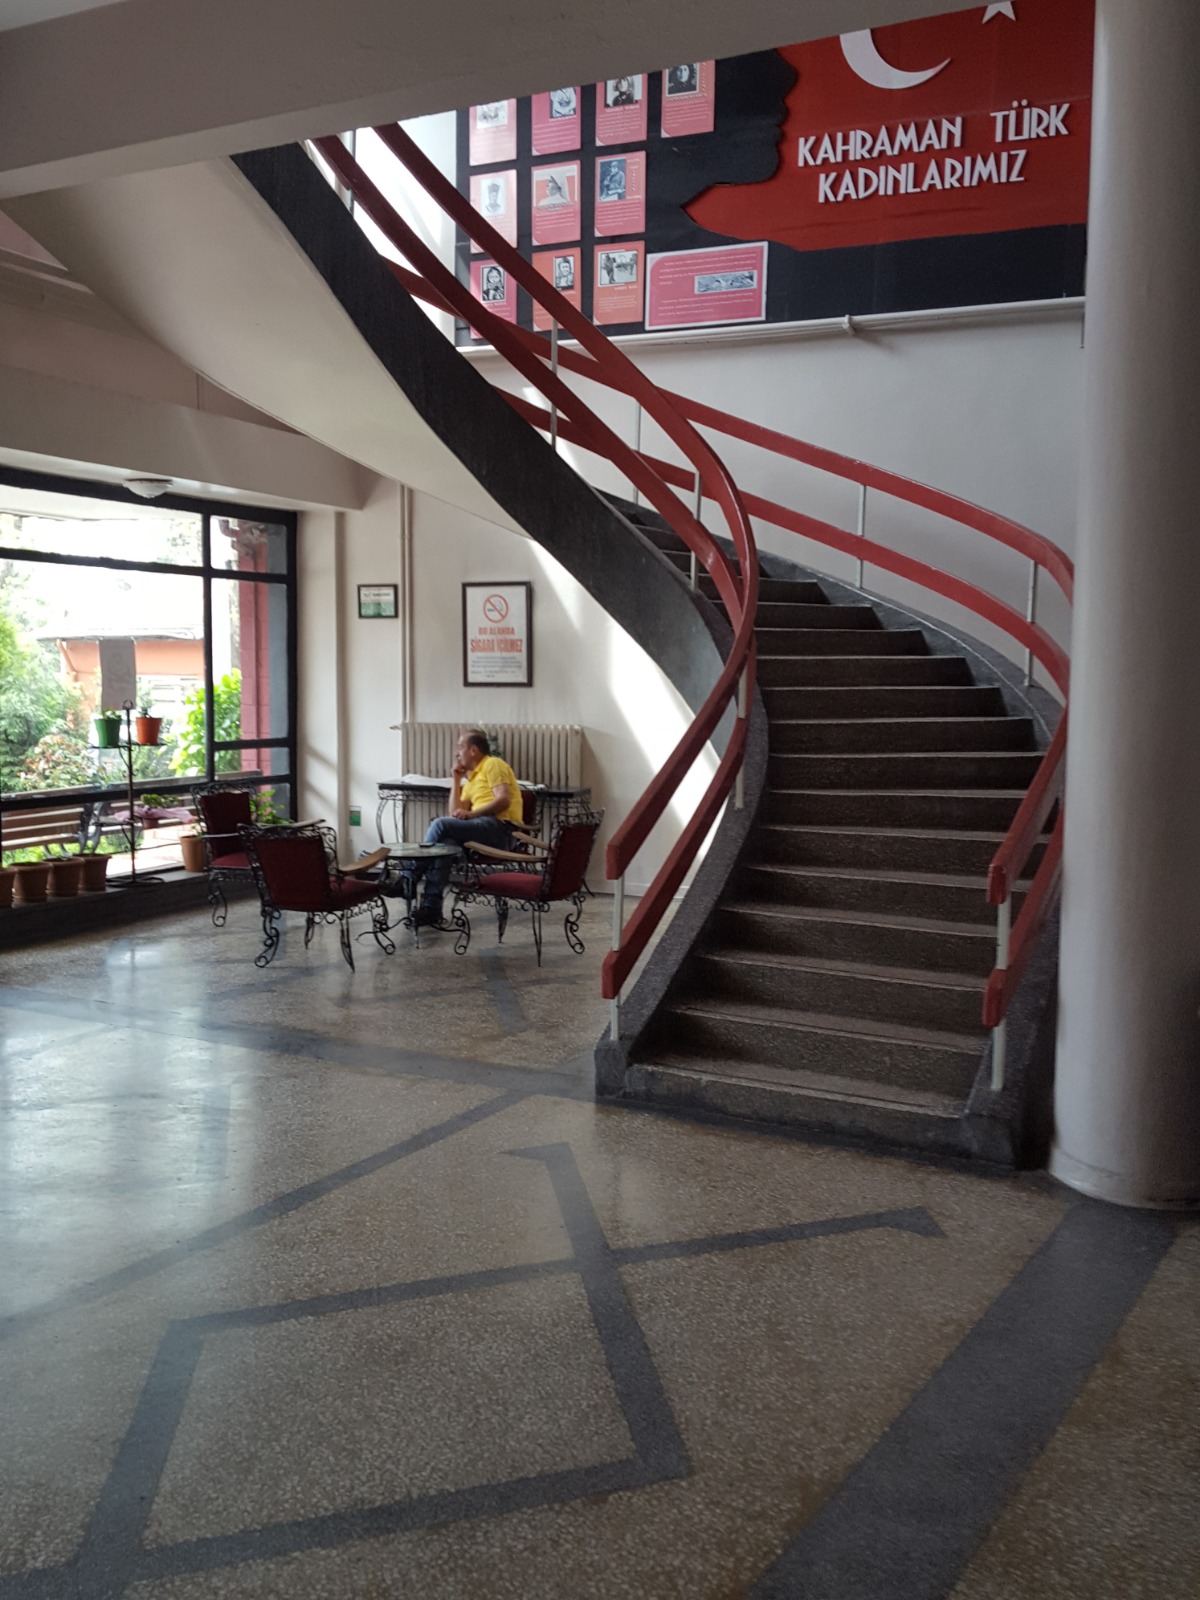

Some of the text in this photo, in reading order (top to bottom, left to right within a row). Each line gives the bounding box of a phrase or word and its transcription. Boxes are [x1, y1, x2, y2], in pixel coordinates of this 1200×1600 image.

[798, 99, 1070, 167] KAHRAMAN TÜRK
[818, 149, 1027, 203] KADINLARIMIZ
